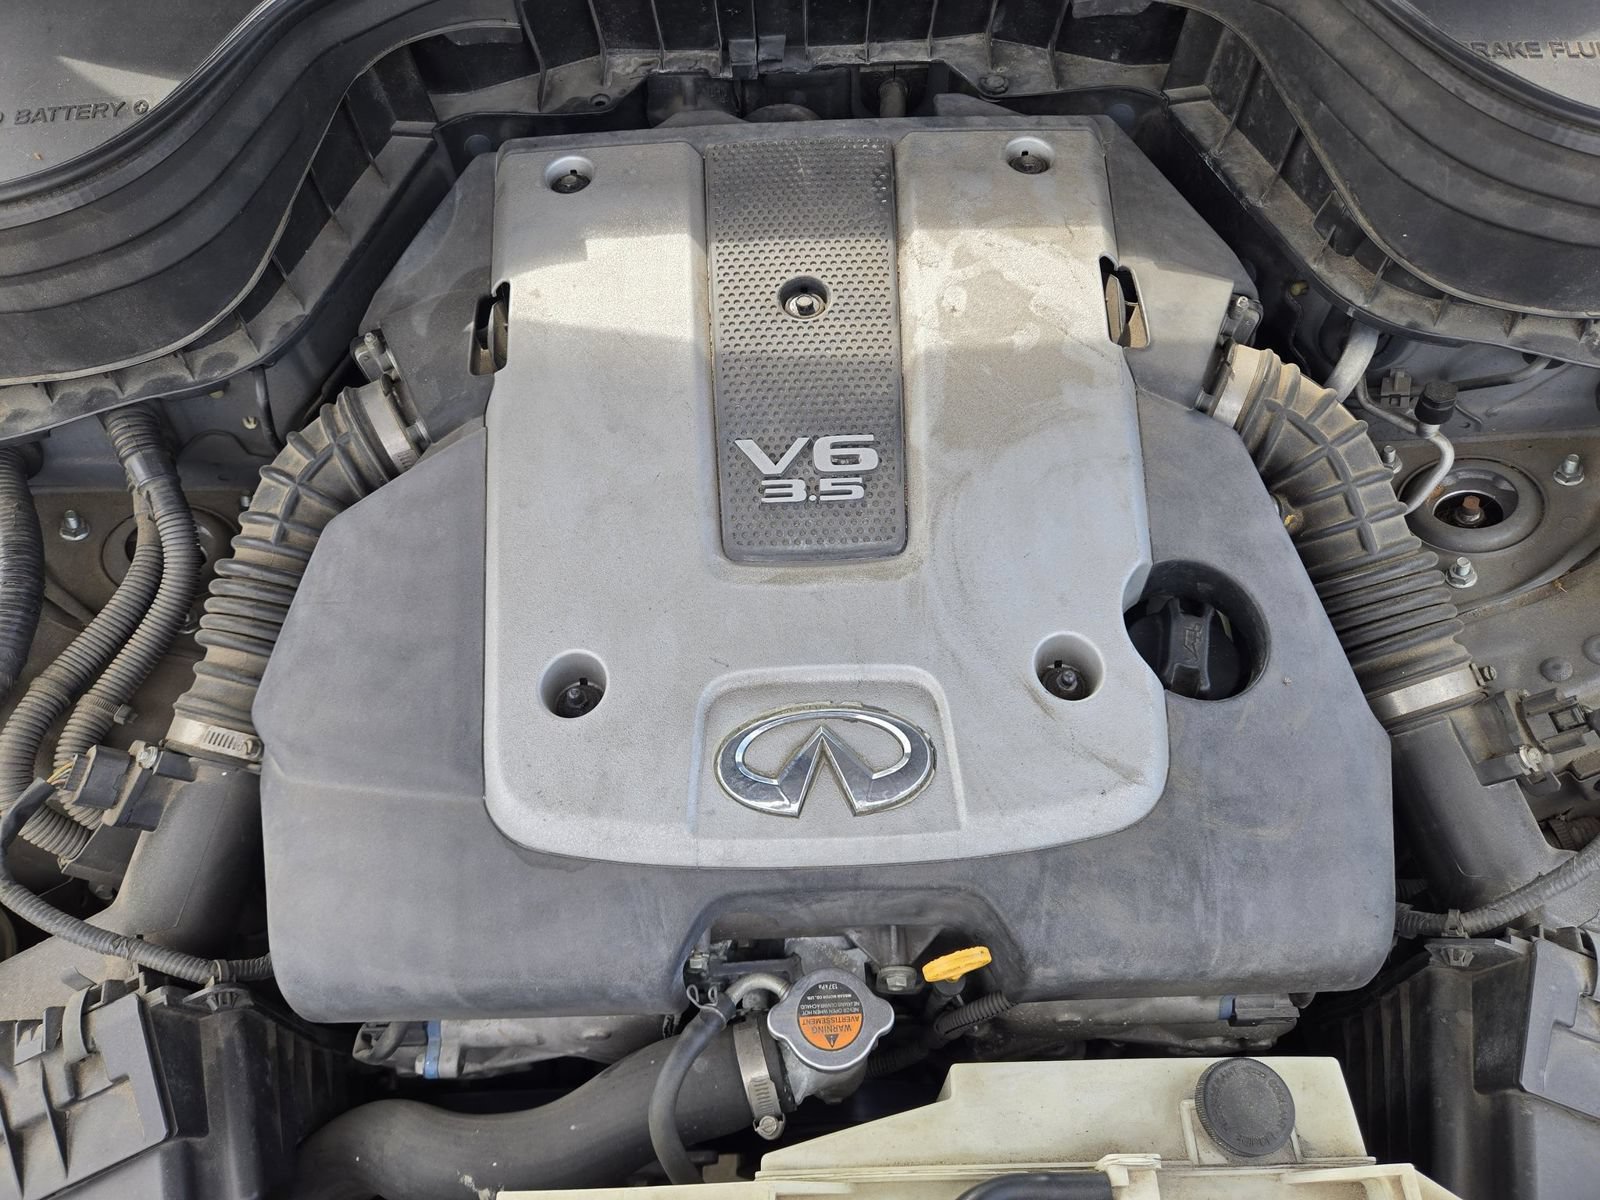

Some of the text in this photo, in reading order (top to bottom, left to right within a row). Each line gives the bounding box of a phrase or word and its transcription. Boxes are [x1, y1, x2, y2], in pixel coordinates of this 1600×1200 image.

[1464, 41, 1543, 59] RAKE
[14, 101, 126, 125] BATTERY
[734, 434, 879, 476] V6
[761, 477, 865, 503] 3.5
[802, 1016, 860, 1025] AVERTISSEMENT
[811, 1024, 852, 1034] WARNING
